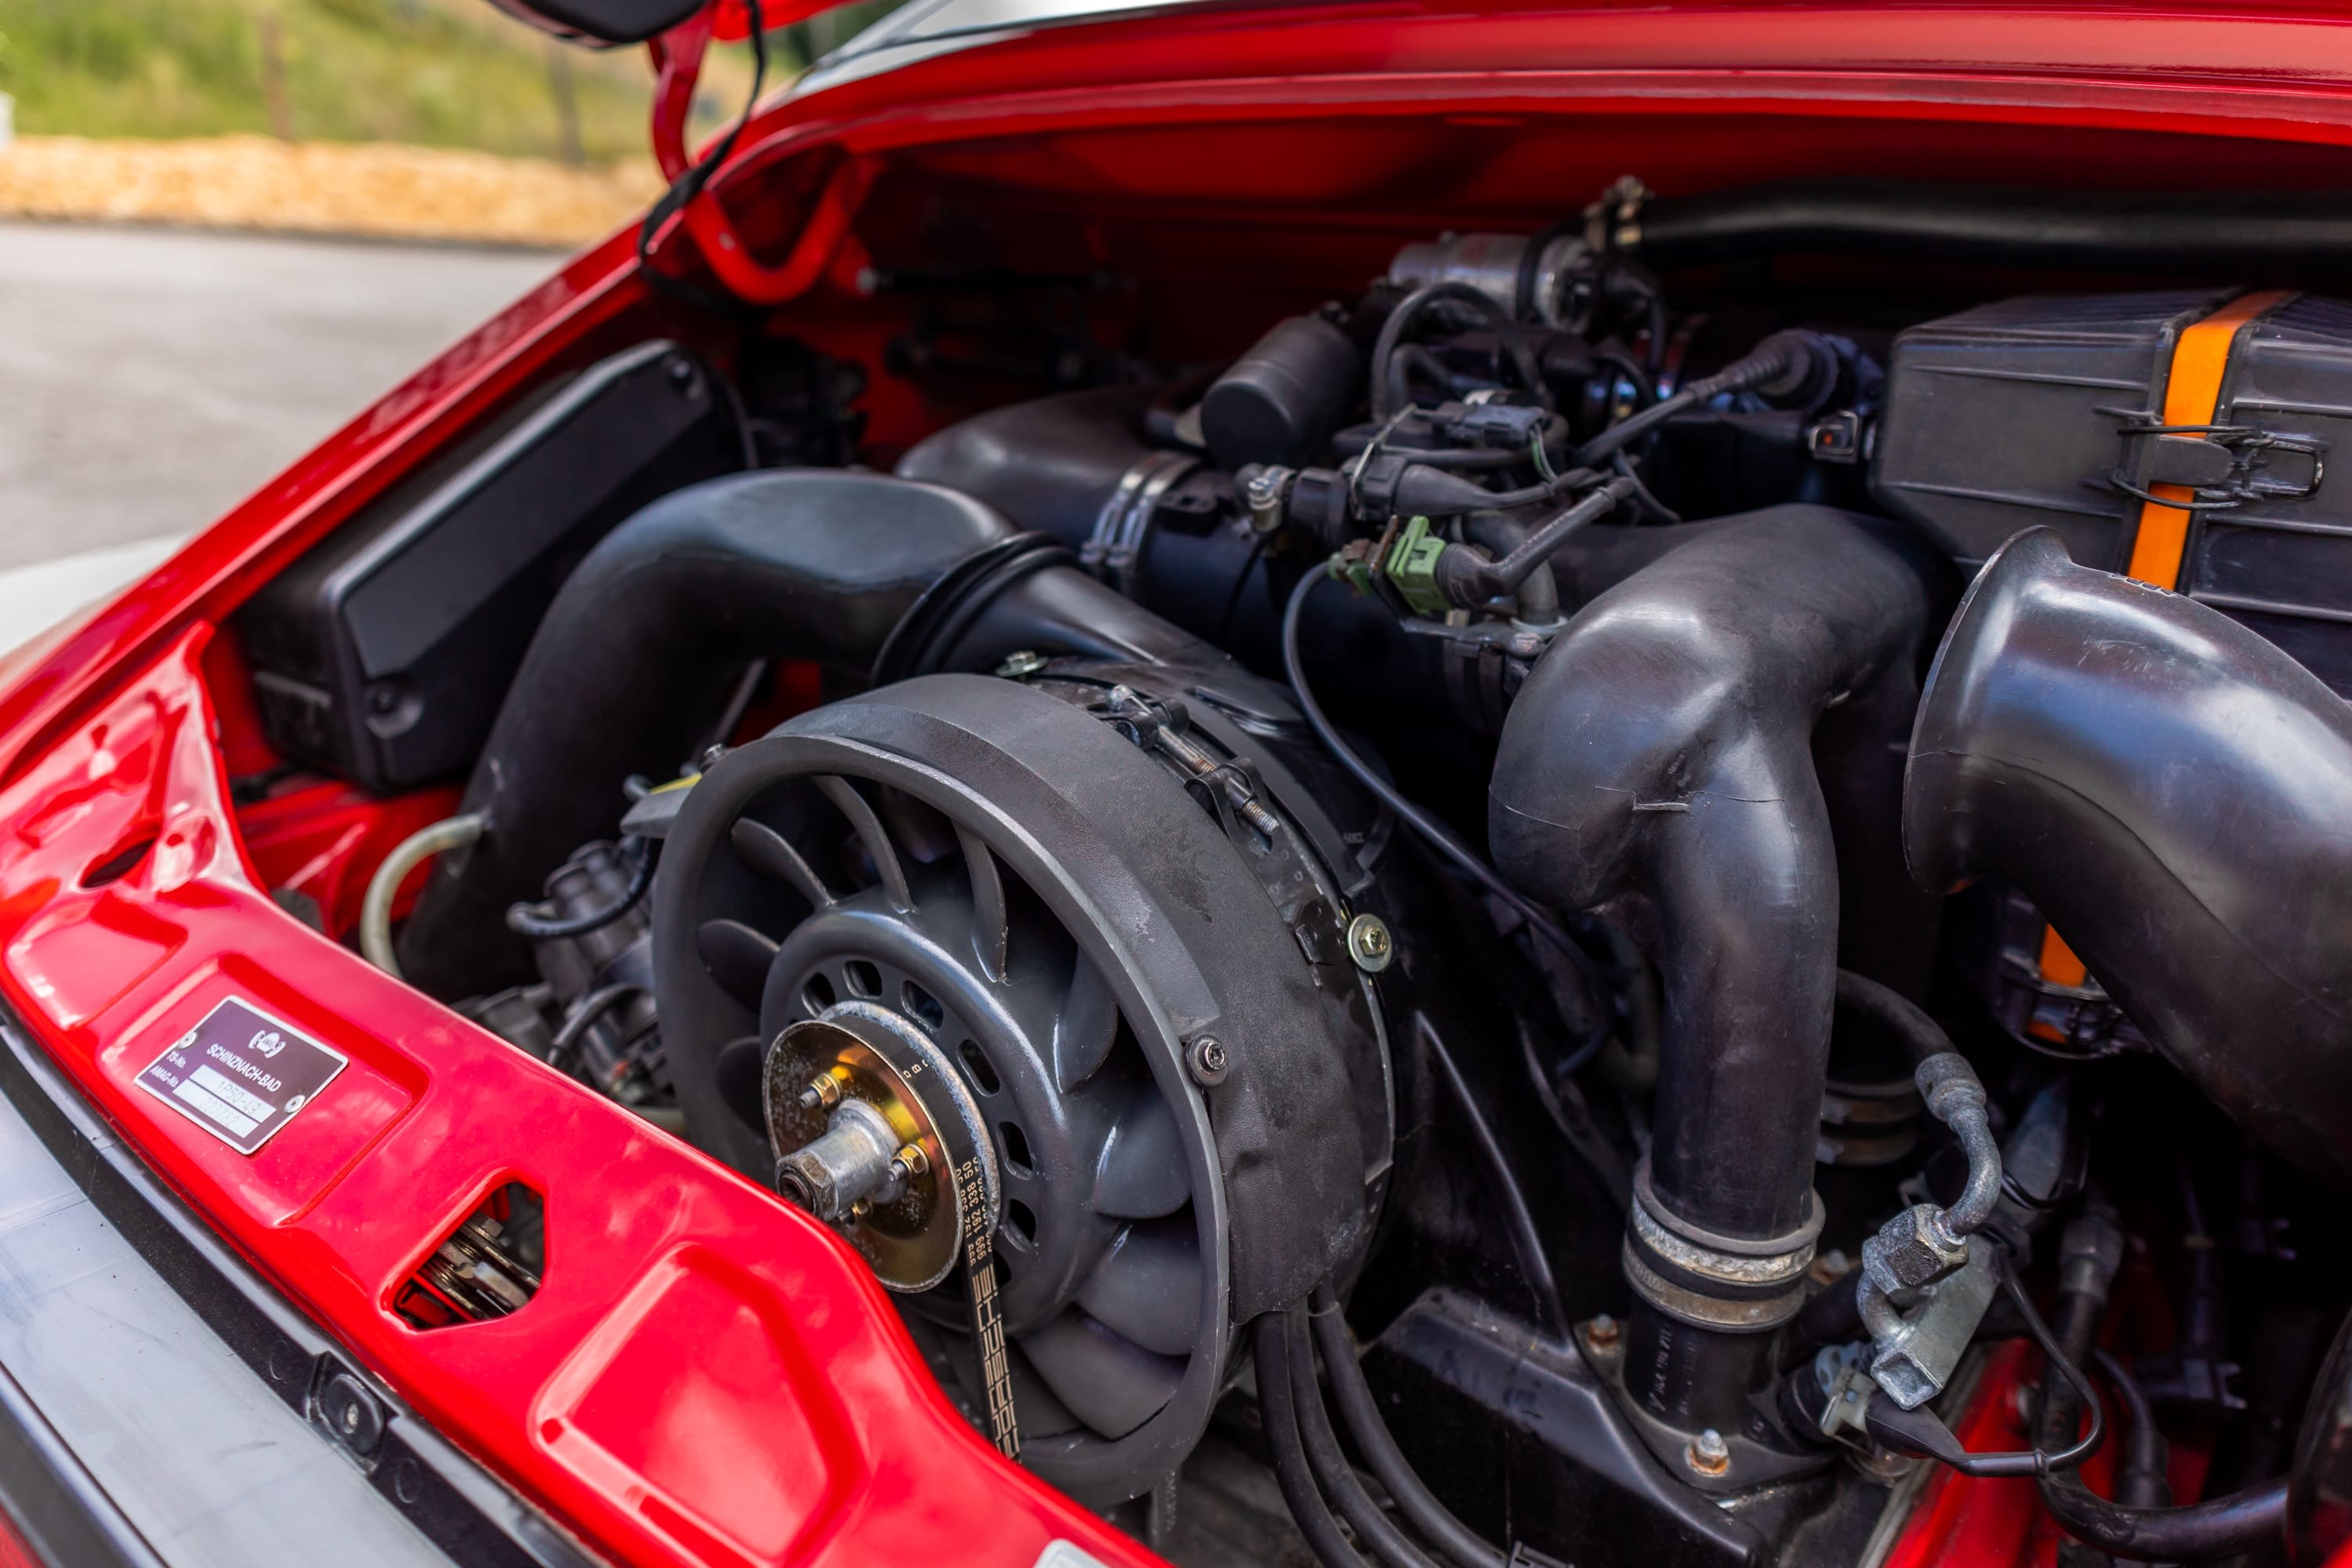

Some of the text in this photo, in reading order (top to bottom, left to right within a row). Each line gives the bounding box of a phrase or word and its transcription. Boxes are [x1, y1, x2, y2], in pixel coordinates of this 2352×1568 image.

[206, 1043, 281, 1092] SCHINZNACH-BAD
[962, 1161, 974, 1180] 50
[967, 1181, 979, 1207] 338
[971, 1208, 983, 1234] 192
[975, 1236, 987, 1261] 999
[979, 1266, 1015, 1460] PORSCHE
